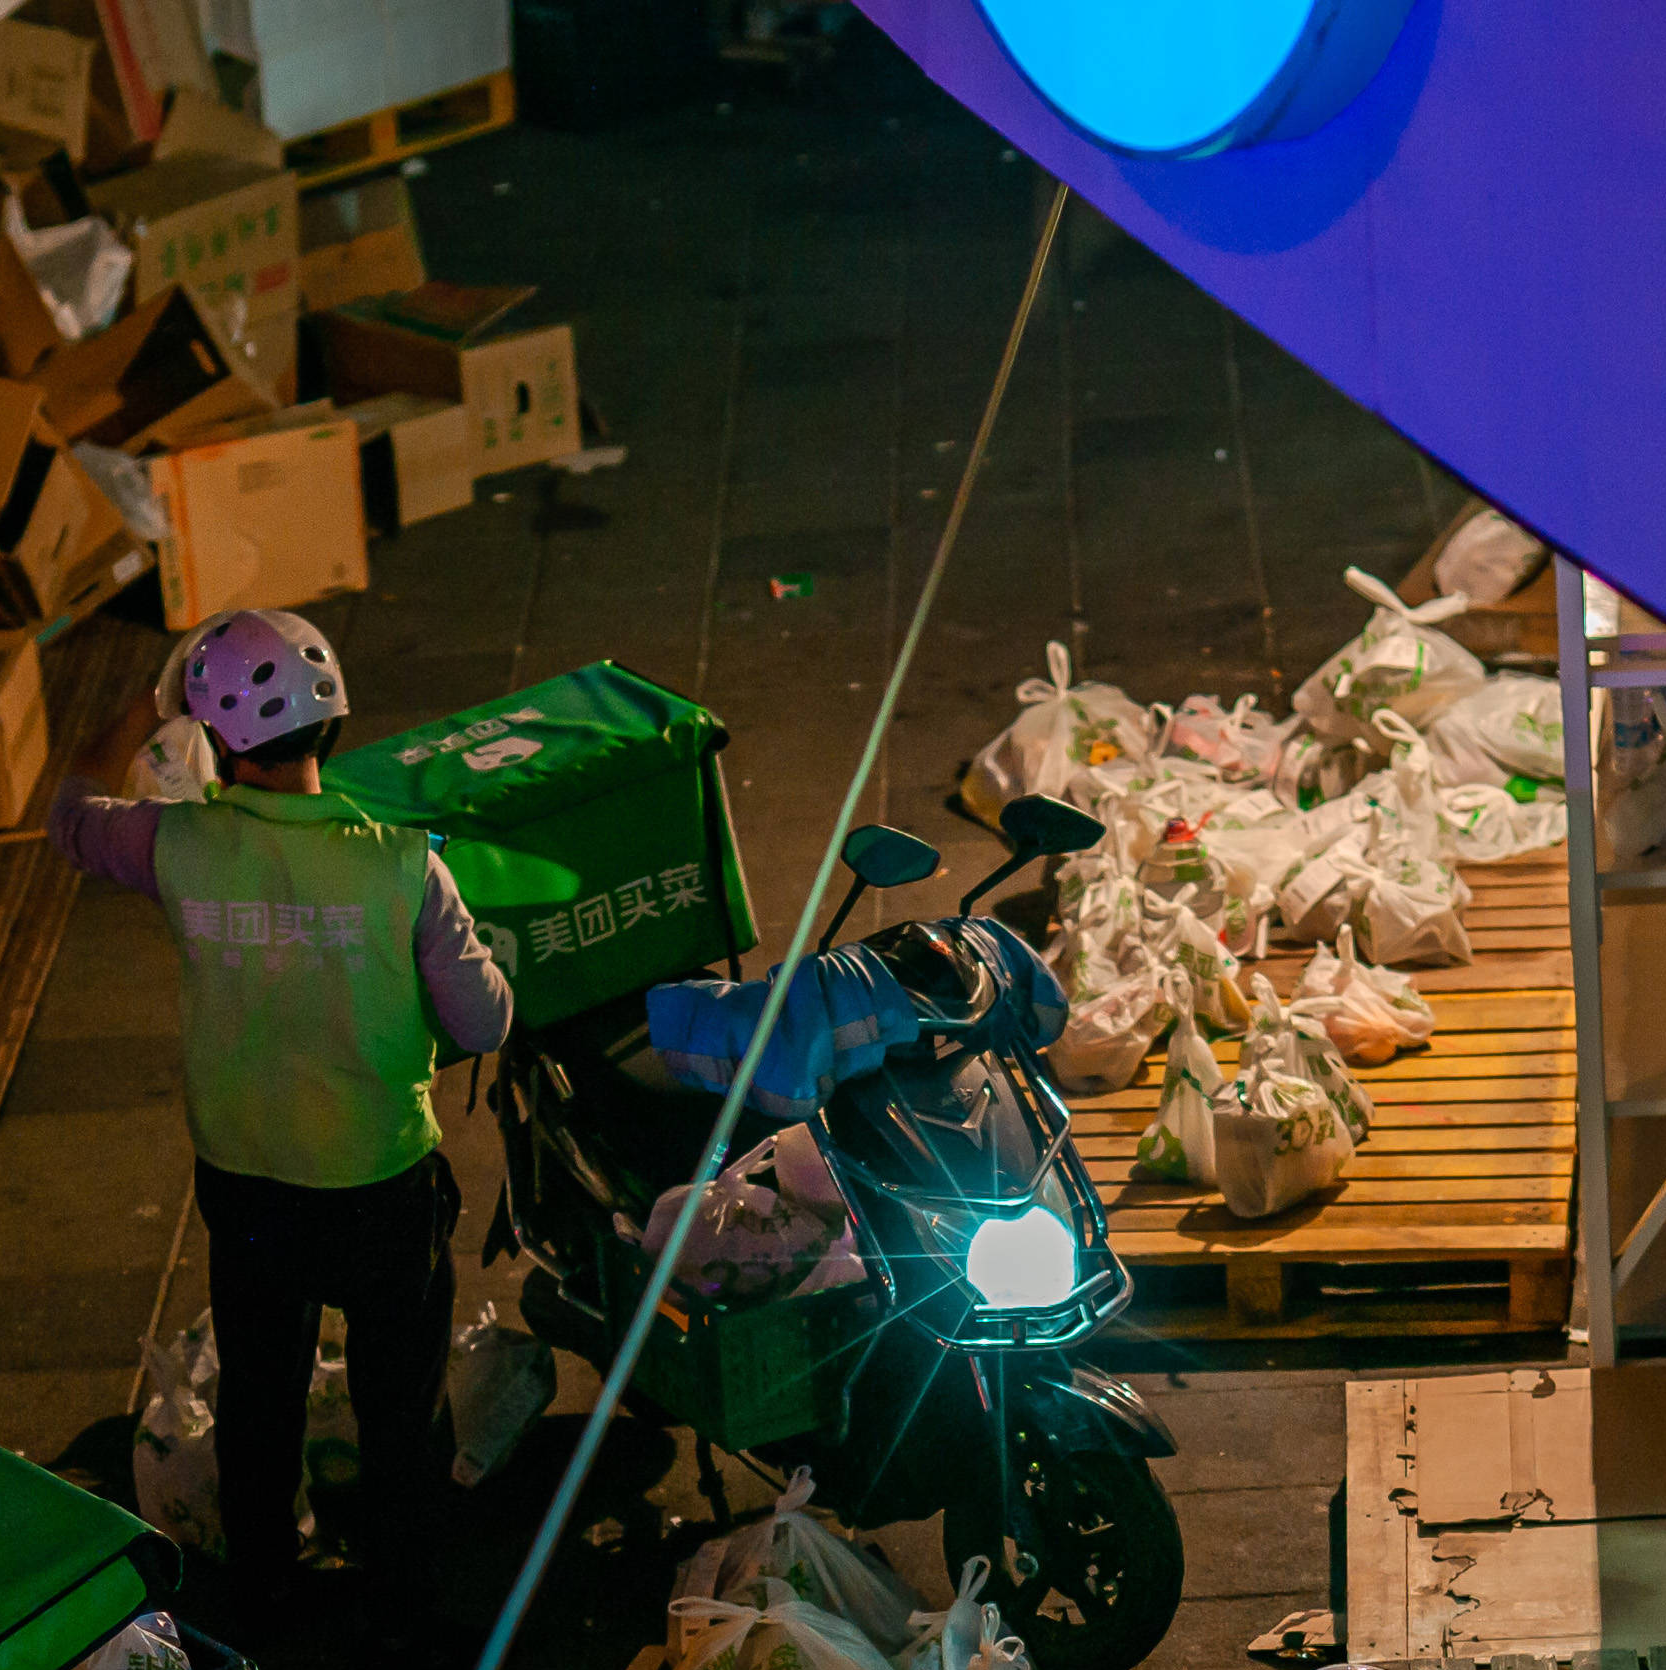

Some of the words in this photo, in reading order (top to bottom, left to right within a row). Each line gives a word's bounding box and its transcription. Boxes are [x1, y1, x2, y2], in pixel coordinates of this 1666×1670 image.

[180, 899, 365, 948] 美团买菜
[527, 862, 708, 964] 美团买菜
